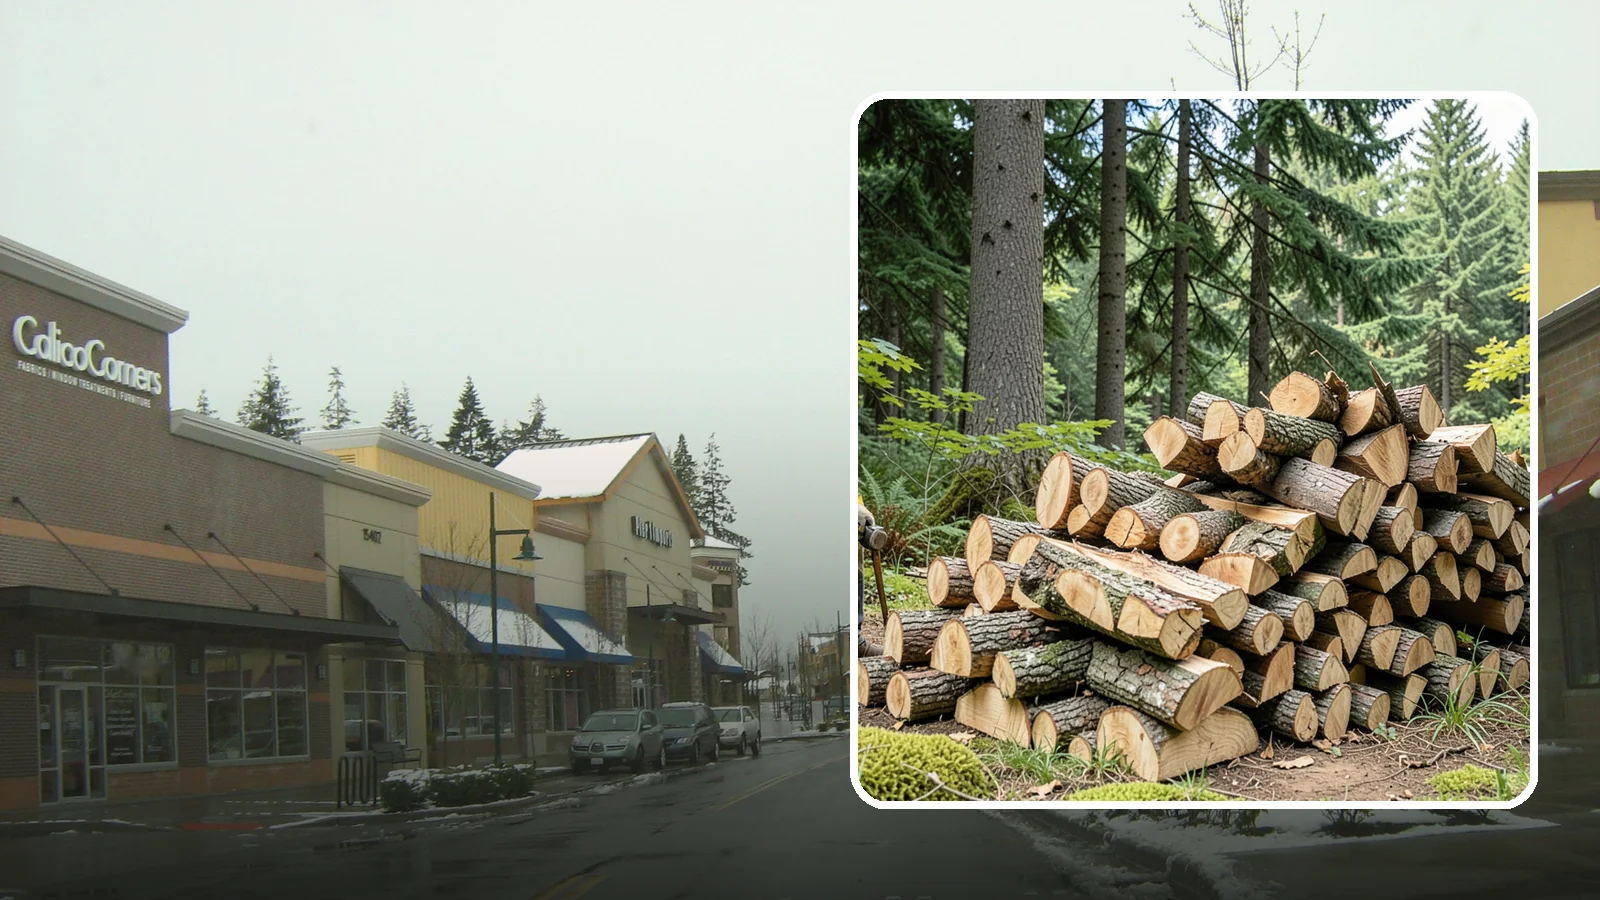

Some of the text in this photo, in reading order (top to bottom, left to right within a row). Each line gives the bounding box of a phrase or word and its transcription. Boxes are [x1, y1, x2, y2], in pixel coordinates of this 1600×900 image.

[16, 359, 151, 409] FABRICS WINDOW TREATMENTS FURNITURE
